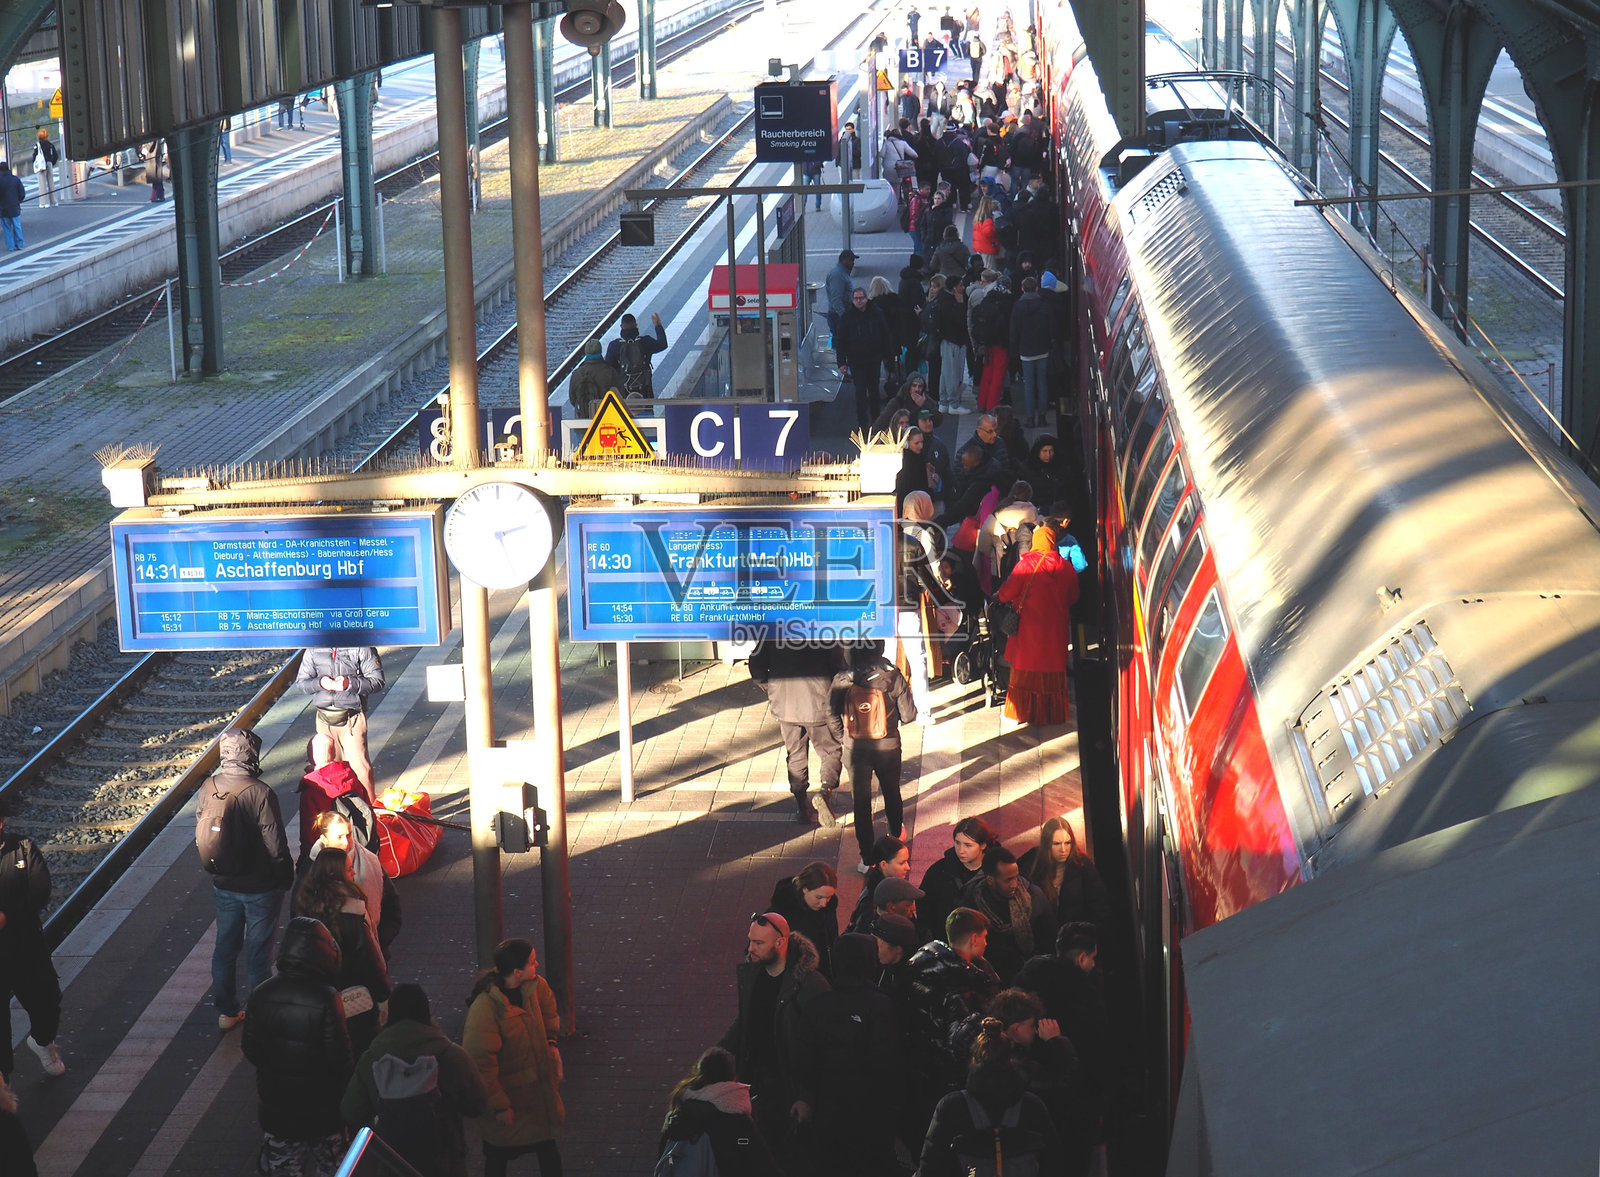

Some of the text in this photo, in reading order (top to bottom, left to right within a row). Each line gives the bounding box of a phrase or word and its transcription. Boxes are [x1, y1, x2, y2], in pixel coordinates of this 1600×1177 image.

[906, 50, 945, 68] B 7
[761, 129, 825, 139] Raucherbereich
[770, 140, 799, 148] Smoking
[690, 409, 800, 458] C 7
[213, 541, 256, 550] Darmstadt
[258, 540, 277, 549] Nord
[285, 539, 350, 548] DA-Kranichstein
[359, 538, 388, 547] Messel
[587, 543, 610, 552] RE 60
[668, 542, 723, 552] Langen(Hess)
[135, 553, 157, 562] RB 75
[213, 551, 244, 560] Dieburg
[252, 549, 309, 560] Altheim(Hess)
[317, 548, 393, 558] Babenhausen/Hess
[588, 554, 632, 570] 14:30
[668, 551, 821, 570] Frankfurt(Main)Hbf
[136, 563, 177, 580] 14:31
[215, 559, 365, 579] Aschaffenburg Hbf
[612, 604, 633, 612] 14:54
[670, 603, 681, 612] RE
[700, 602, 733, 611] Ankunft
[160, 609, 389, 622] 15:12 RB 75 Mainz-Bischofsheim via Groß Gerau
[612, 612, 876, 623] 15:30 RE 60 Frankfurt(M)Hbf A-E
[161, 620, 374, 632] 15:31 RB 75 Aschaffenburg Hbf via Dieburg
